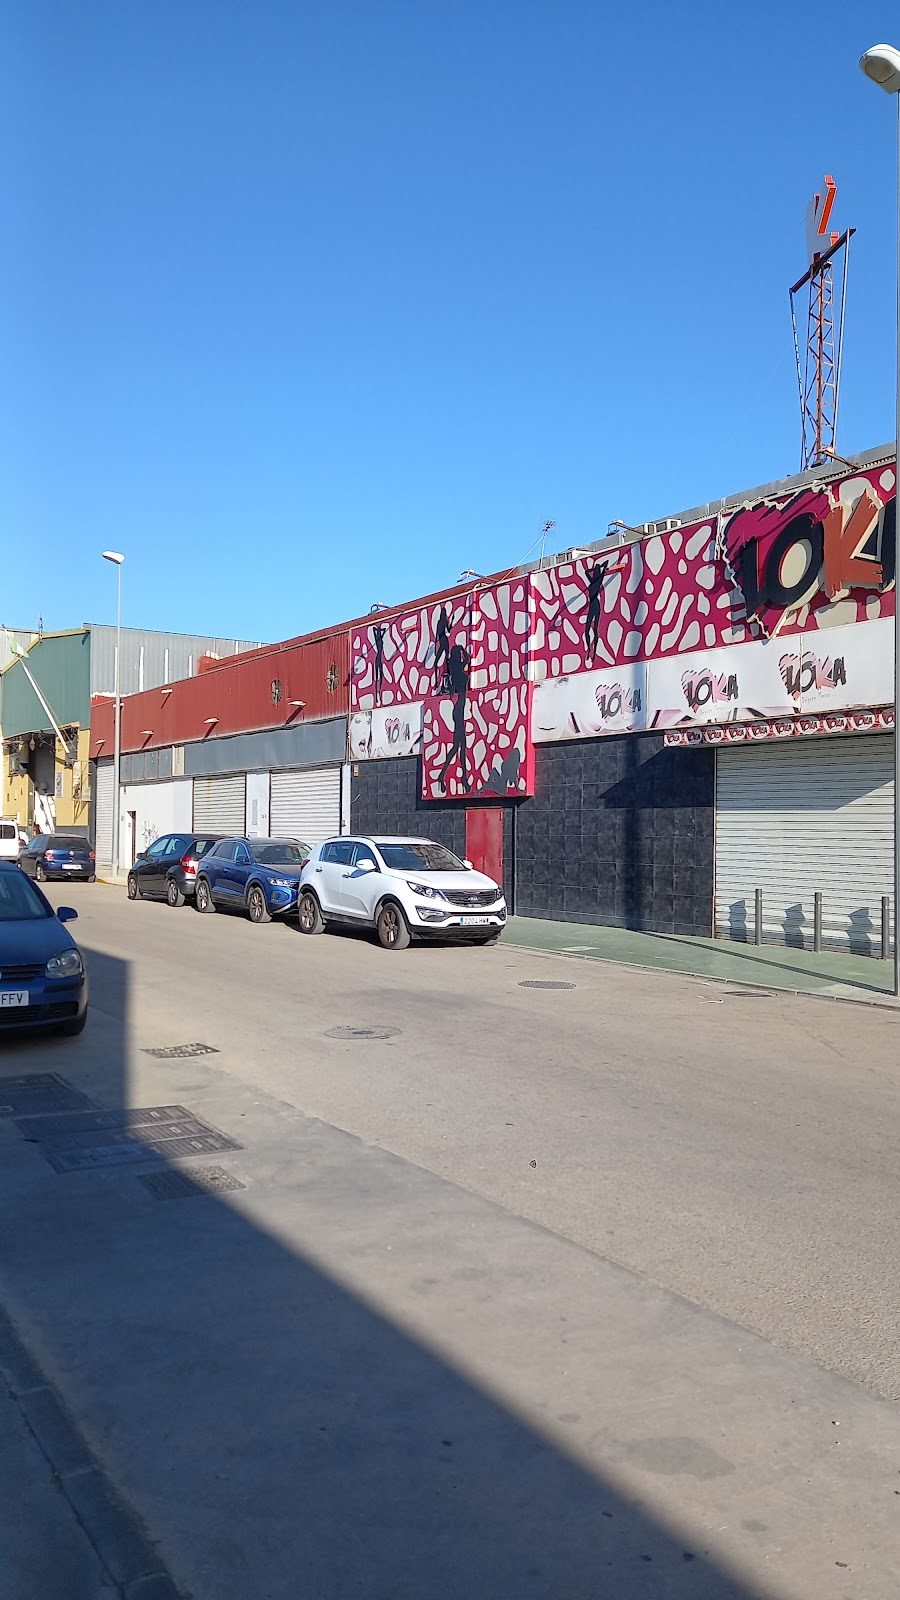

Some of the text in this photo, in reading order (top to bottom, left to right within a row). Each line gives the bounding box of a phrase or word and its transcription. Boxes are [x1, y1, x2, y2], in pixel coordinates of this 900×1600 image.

[687, 672, 739, 707] LOKA
[785, 654, 847, 696] LOKA
[600, 688, 642, 718] LOKA
[1, 992, 24, 1005] FFV
